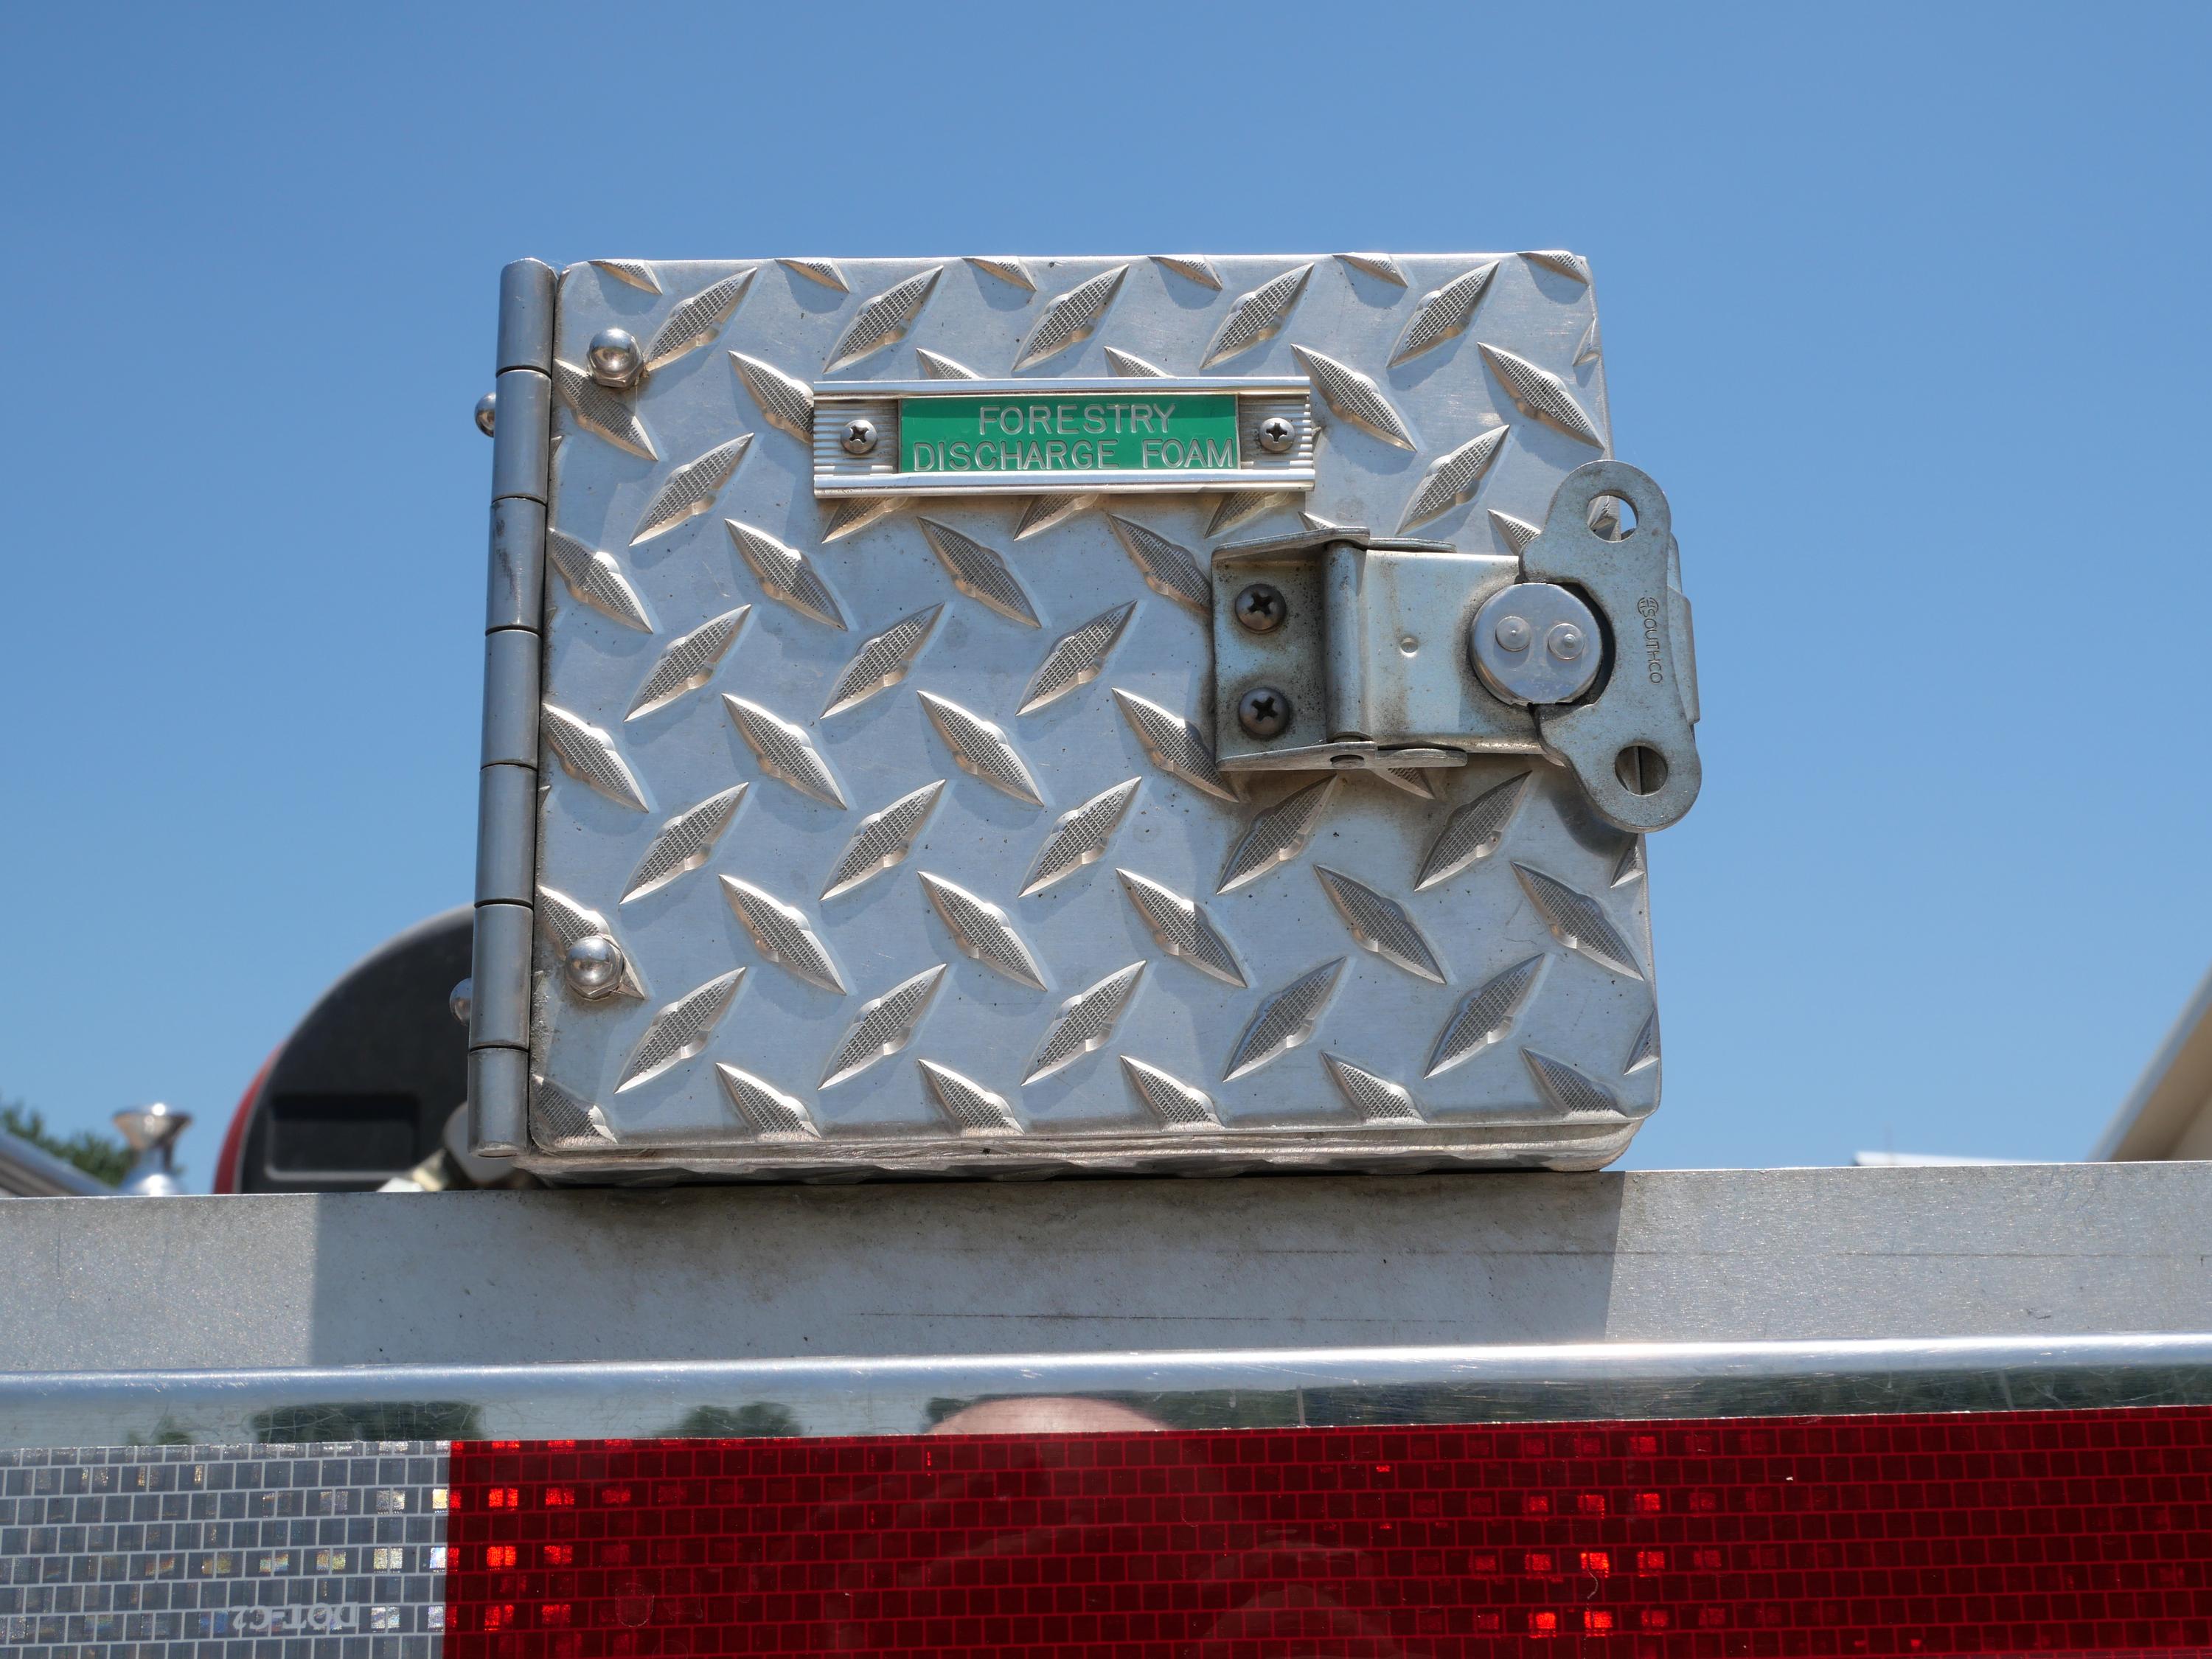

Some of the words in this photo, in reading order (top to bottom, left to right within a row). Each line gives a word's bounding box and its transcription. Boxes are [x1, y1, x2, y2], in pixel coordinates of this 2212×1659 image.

[979, 403, 1176, 435] FORESTRY
[914, 439, 1119, 472] DISCHARGE
[1142, 438, 1234, 470] FOAM
[1643, 608, 1663, 684] SOUTHCO
[232, 1602, 360, 1630] DOT-C2
